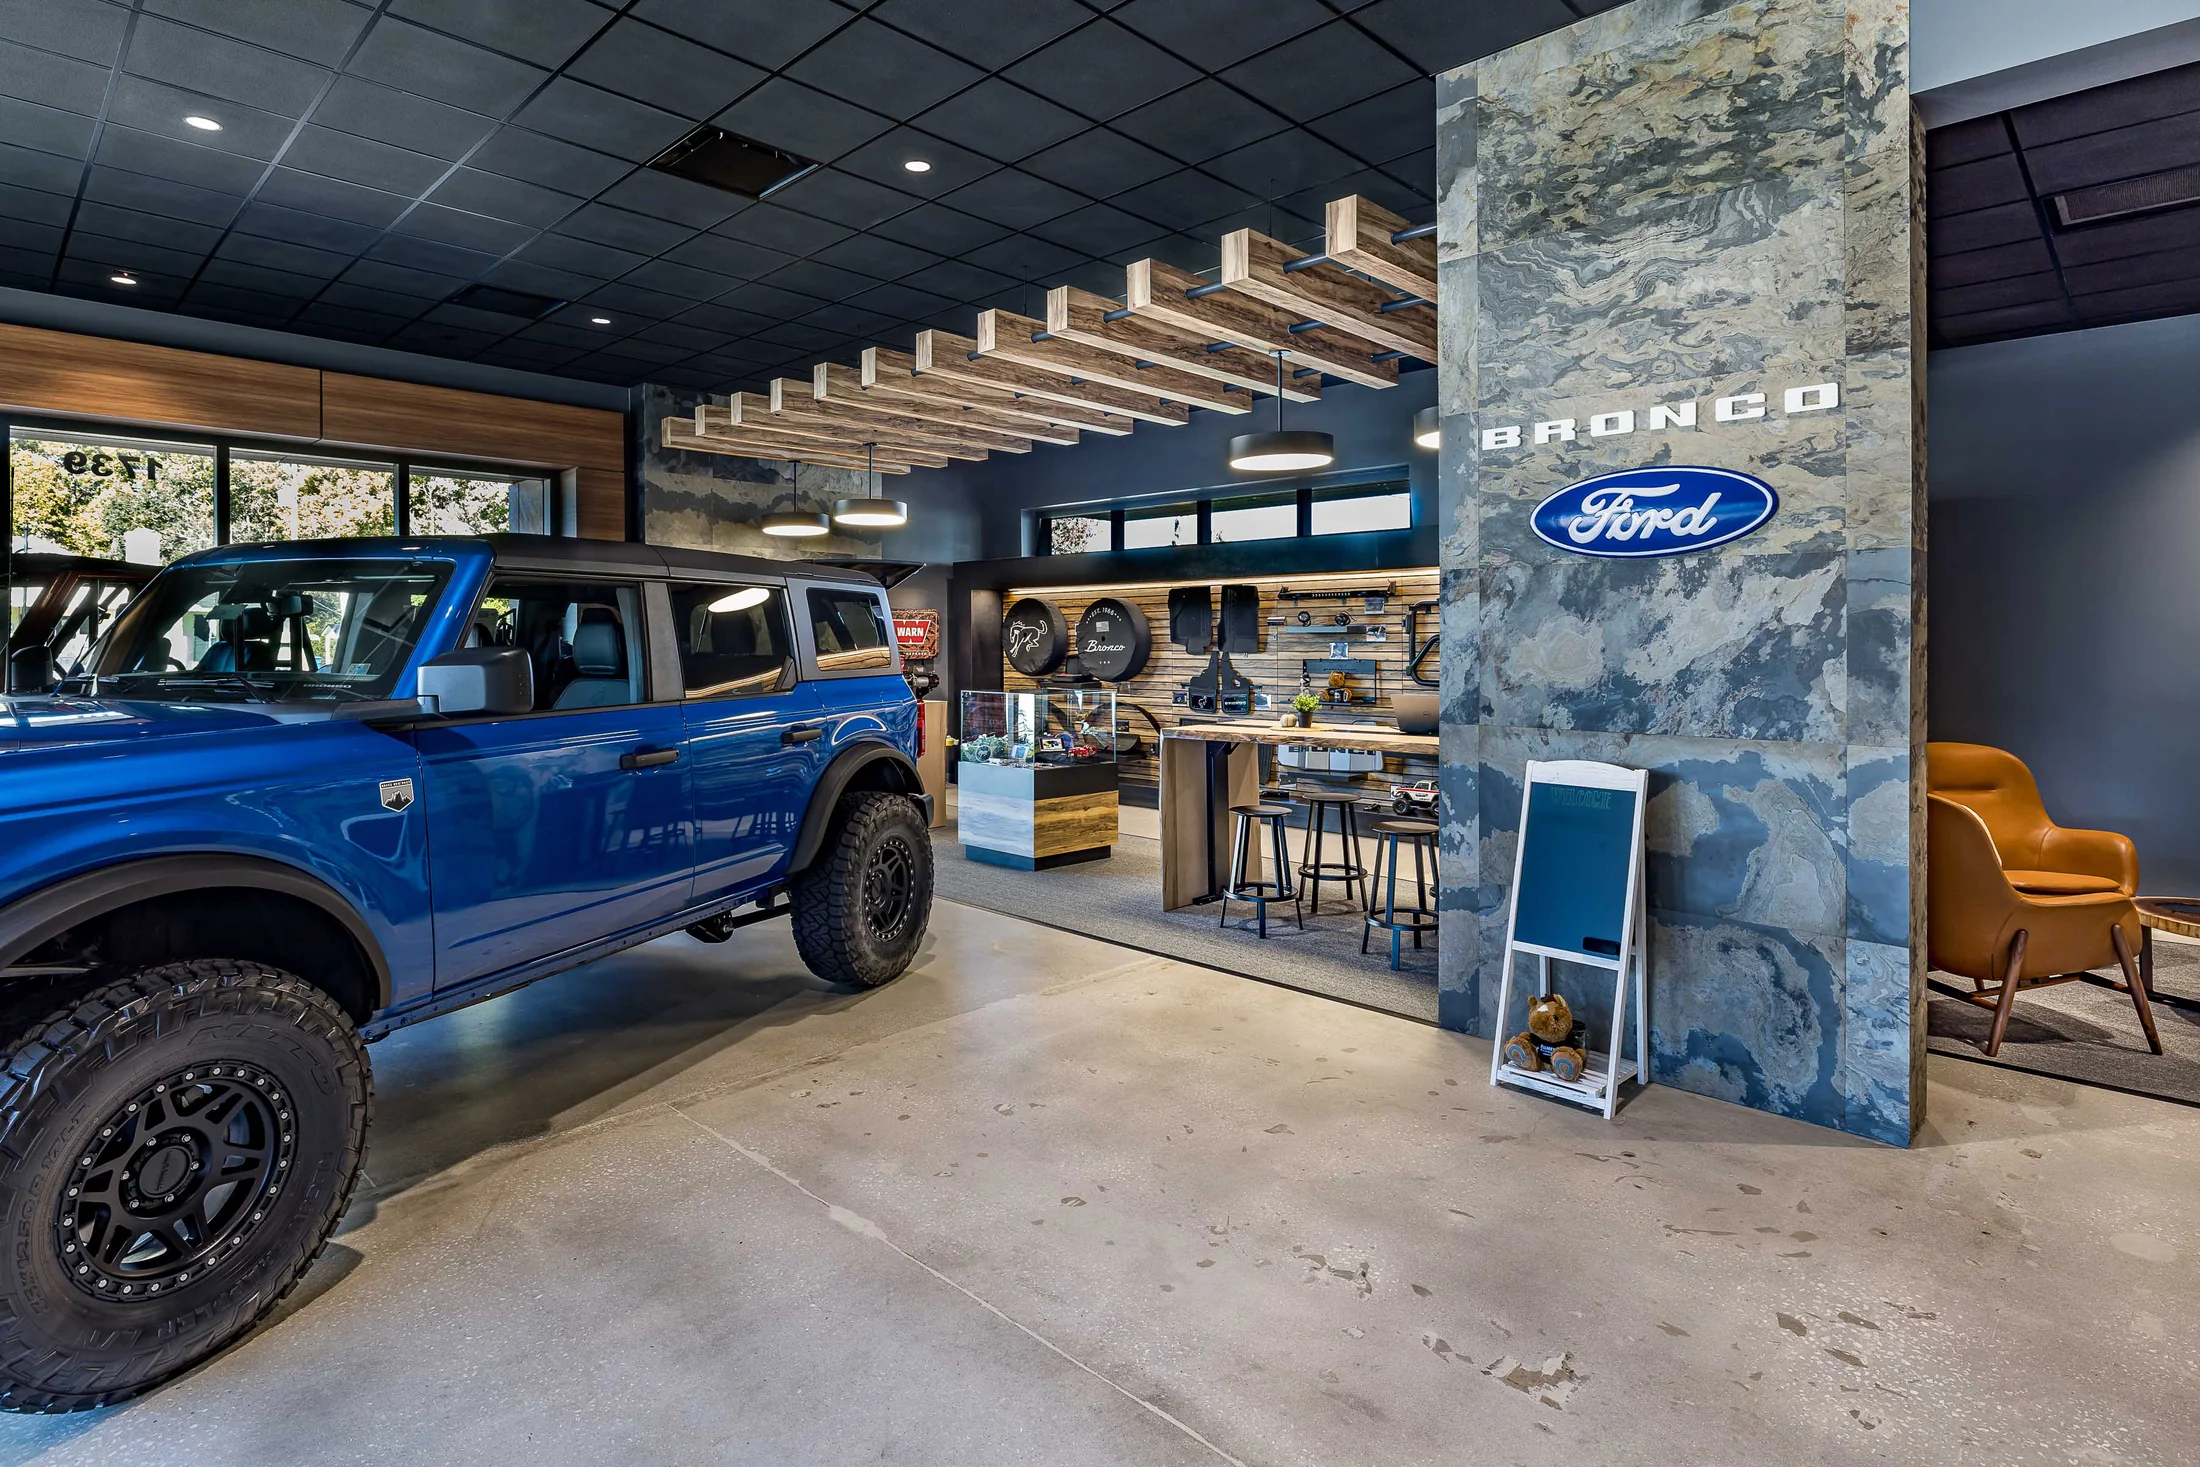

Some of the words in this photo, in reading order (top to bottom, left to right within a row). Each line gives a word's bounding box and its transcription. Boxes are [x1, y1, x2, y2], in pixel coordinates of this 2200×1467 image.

[1482, 382, 1839, 451] BRONCO
[1567, 483, 1722, 544] Ford
[897, 627, 924, 637] WARN
[1084, 640, 1125, 652] Bronco
[1551, 787, 1612, 810] WELCOME
